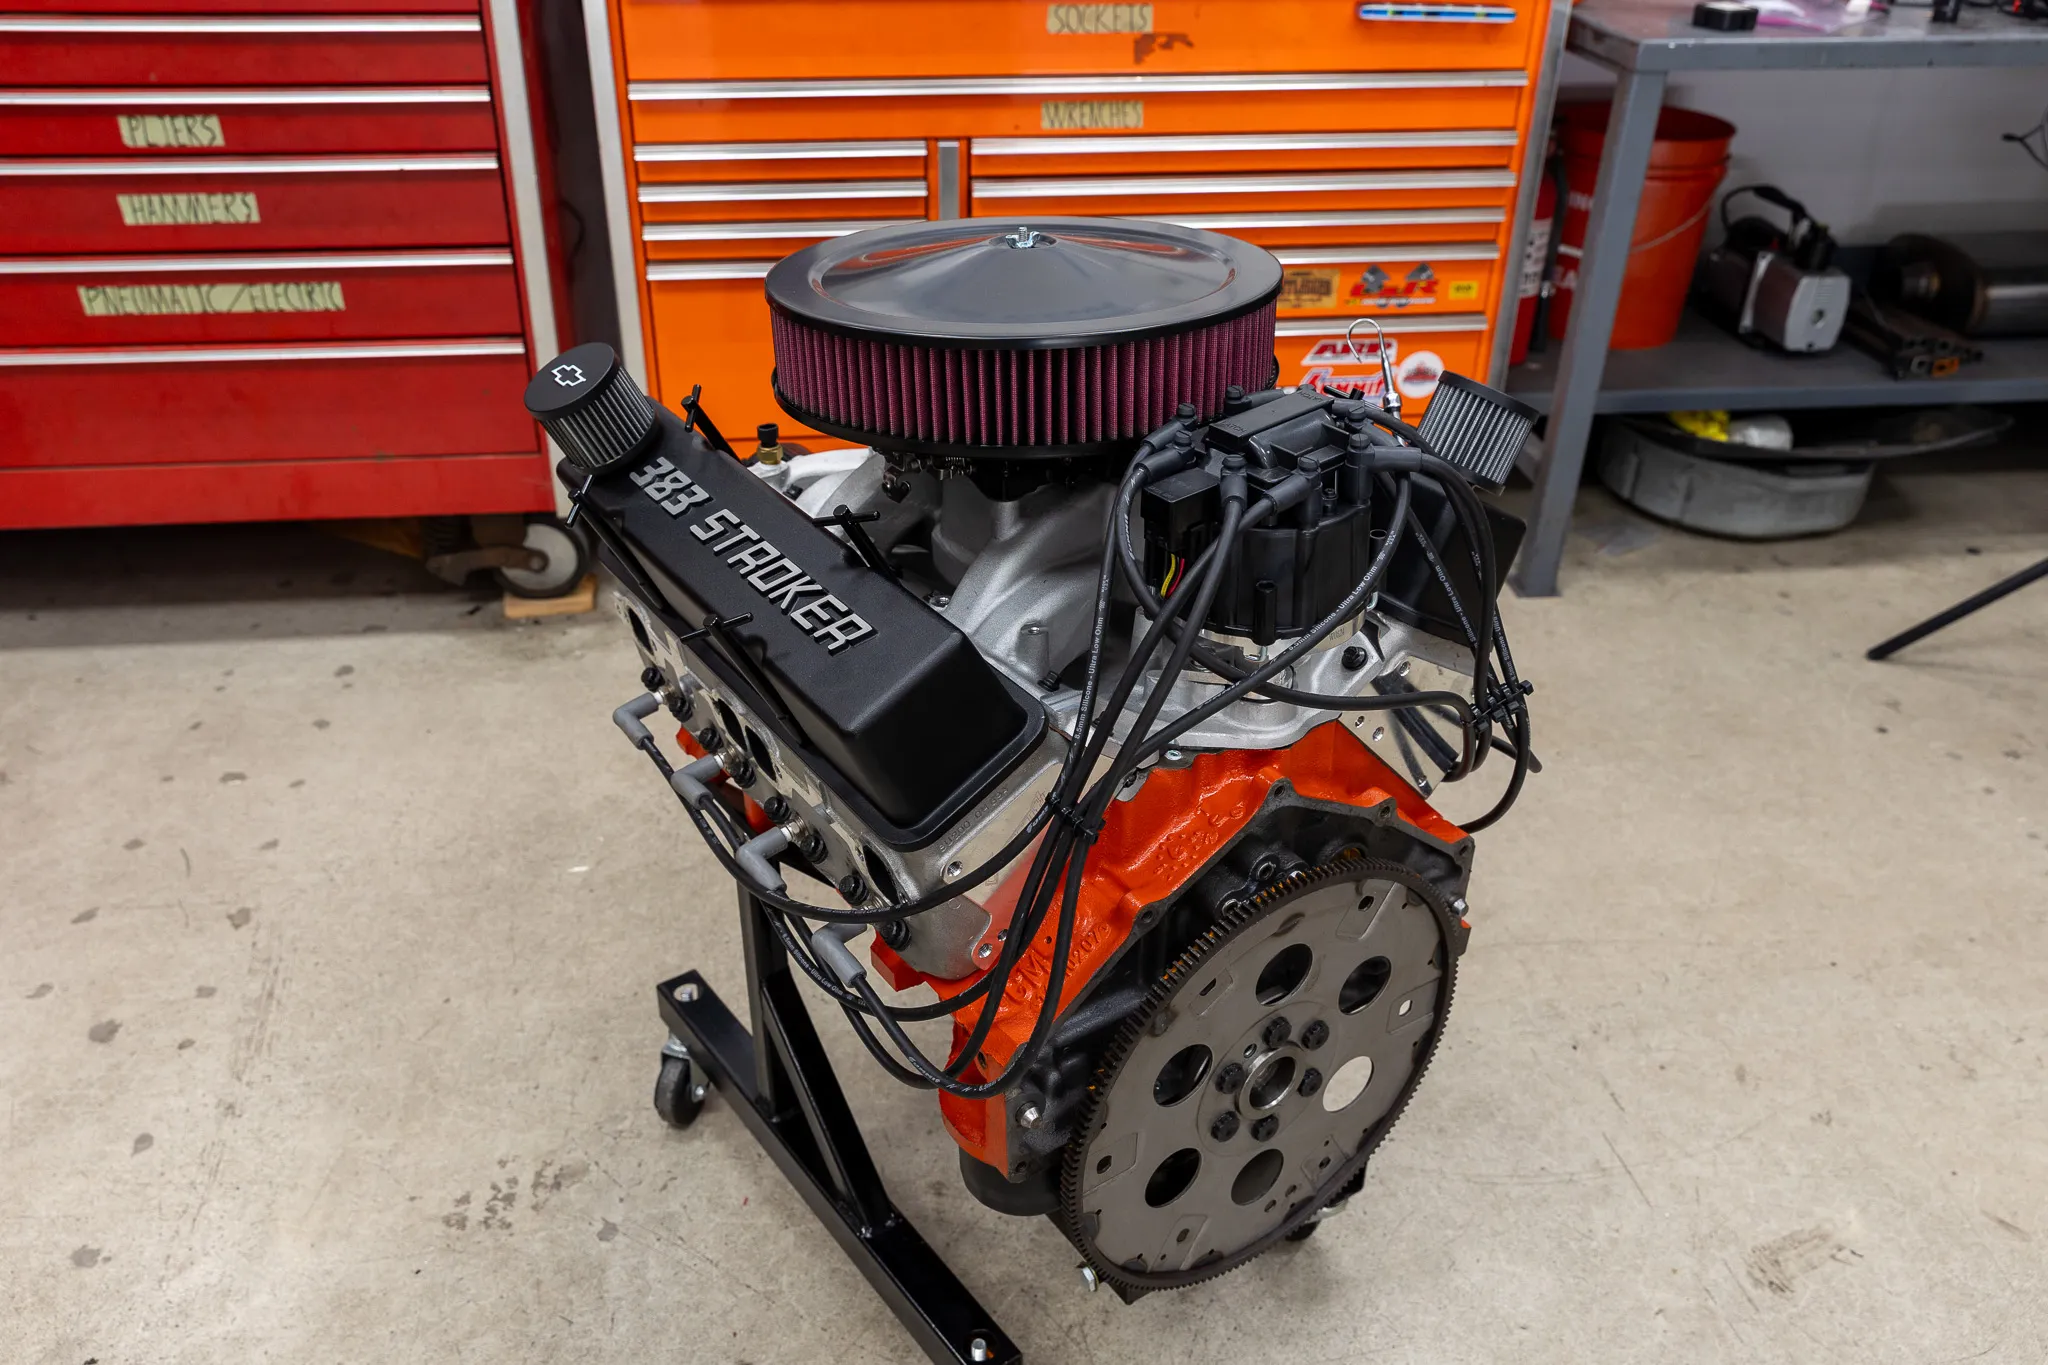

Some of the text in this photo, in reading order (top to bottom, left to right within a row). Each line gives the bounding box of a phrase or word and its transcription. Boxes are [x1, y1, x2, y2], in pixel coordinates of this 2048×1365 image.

[1053, 4, 1149, 33] SOCKETS
[1042, 101, 1141, 129] WRENCHES
[126, 115, 219, 147] PLIERS
[127, 193, 254, 225] HAMMERS
[629, 456, 873, 651] 383 STROKER
[1435, 564, 1446, 583] Ohm
[1339, 595, 1354, 609] Ultra
[1353, 581, 1366, 595] Low
[1363, 565, 1378, 581] Ohm
[1444, 581, 1454, 597] Low
[1452, 596, 1462, 613] Ultra
[1095, 616, 1104, 636] Ohm
[1462, 615, 1477, 643] Silicone
[1092, 635, 1101, 655] Low
[1088, 652, 1098, 675] Ultra
[1081, 684, 1093, 713] Silicone
[1075, 715, 1086, 740] 8.5mm
[821, 977, 832, 988] Low
